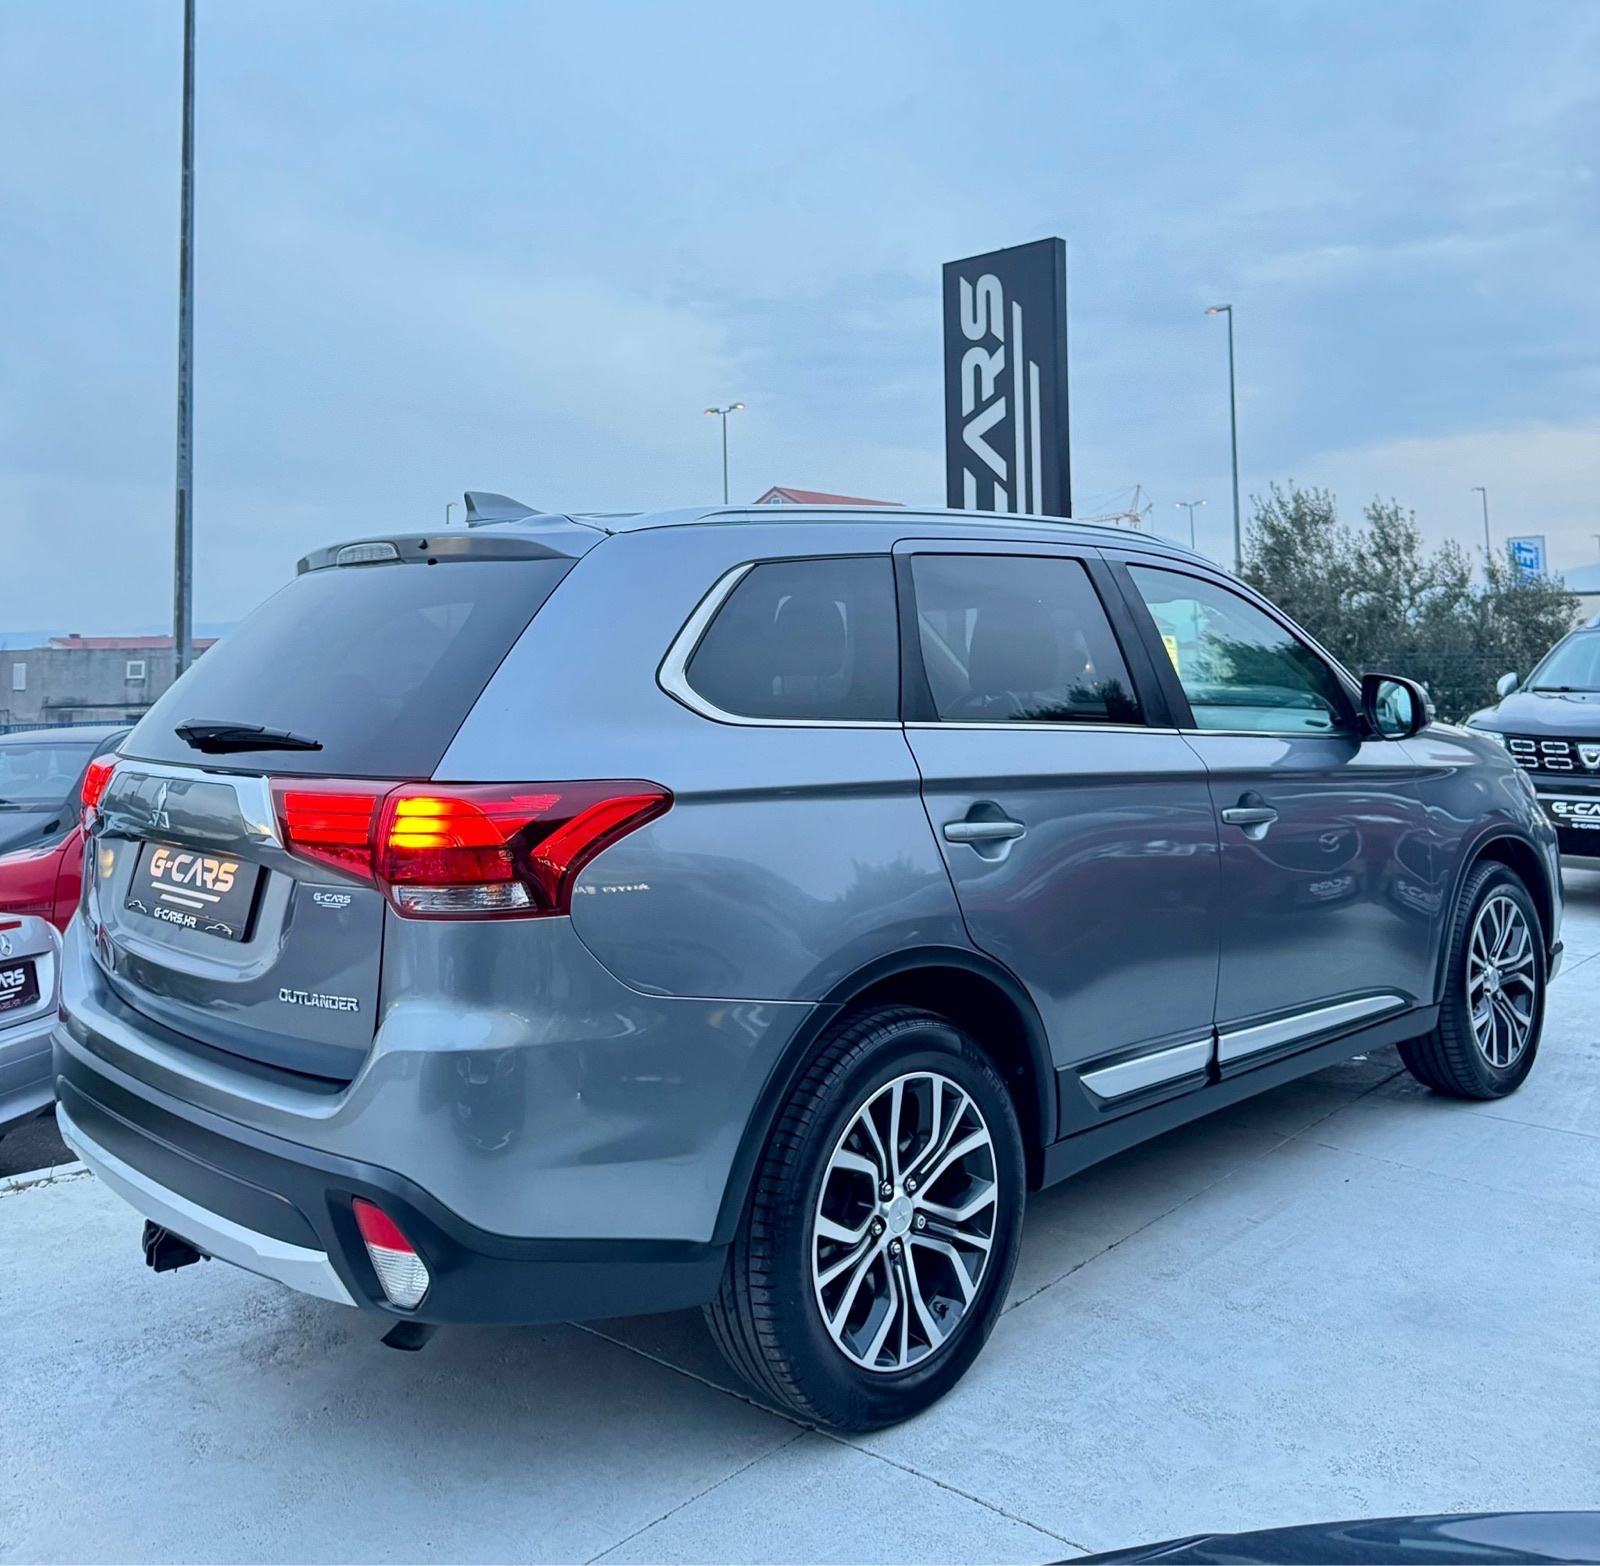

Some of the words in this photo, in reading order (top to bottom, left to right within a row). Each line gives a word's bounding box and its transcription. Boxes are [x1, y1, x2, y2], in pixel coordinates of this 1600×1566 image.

[150, 849, 239, 893] G-CARS
[313, 892, 352, 904] G-CARS
[153, 907, 197, 929] G-CARS.HR
[278, 987, 360, 1012] OUTLANDER
